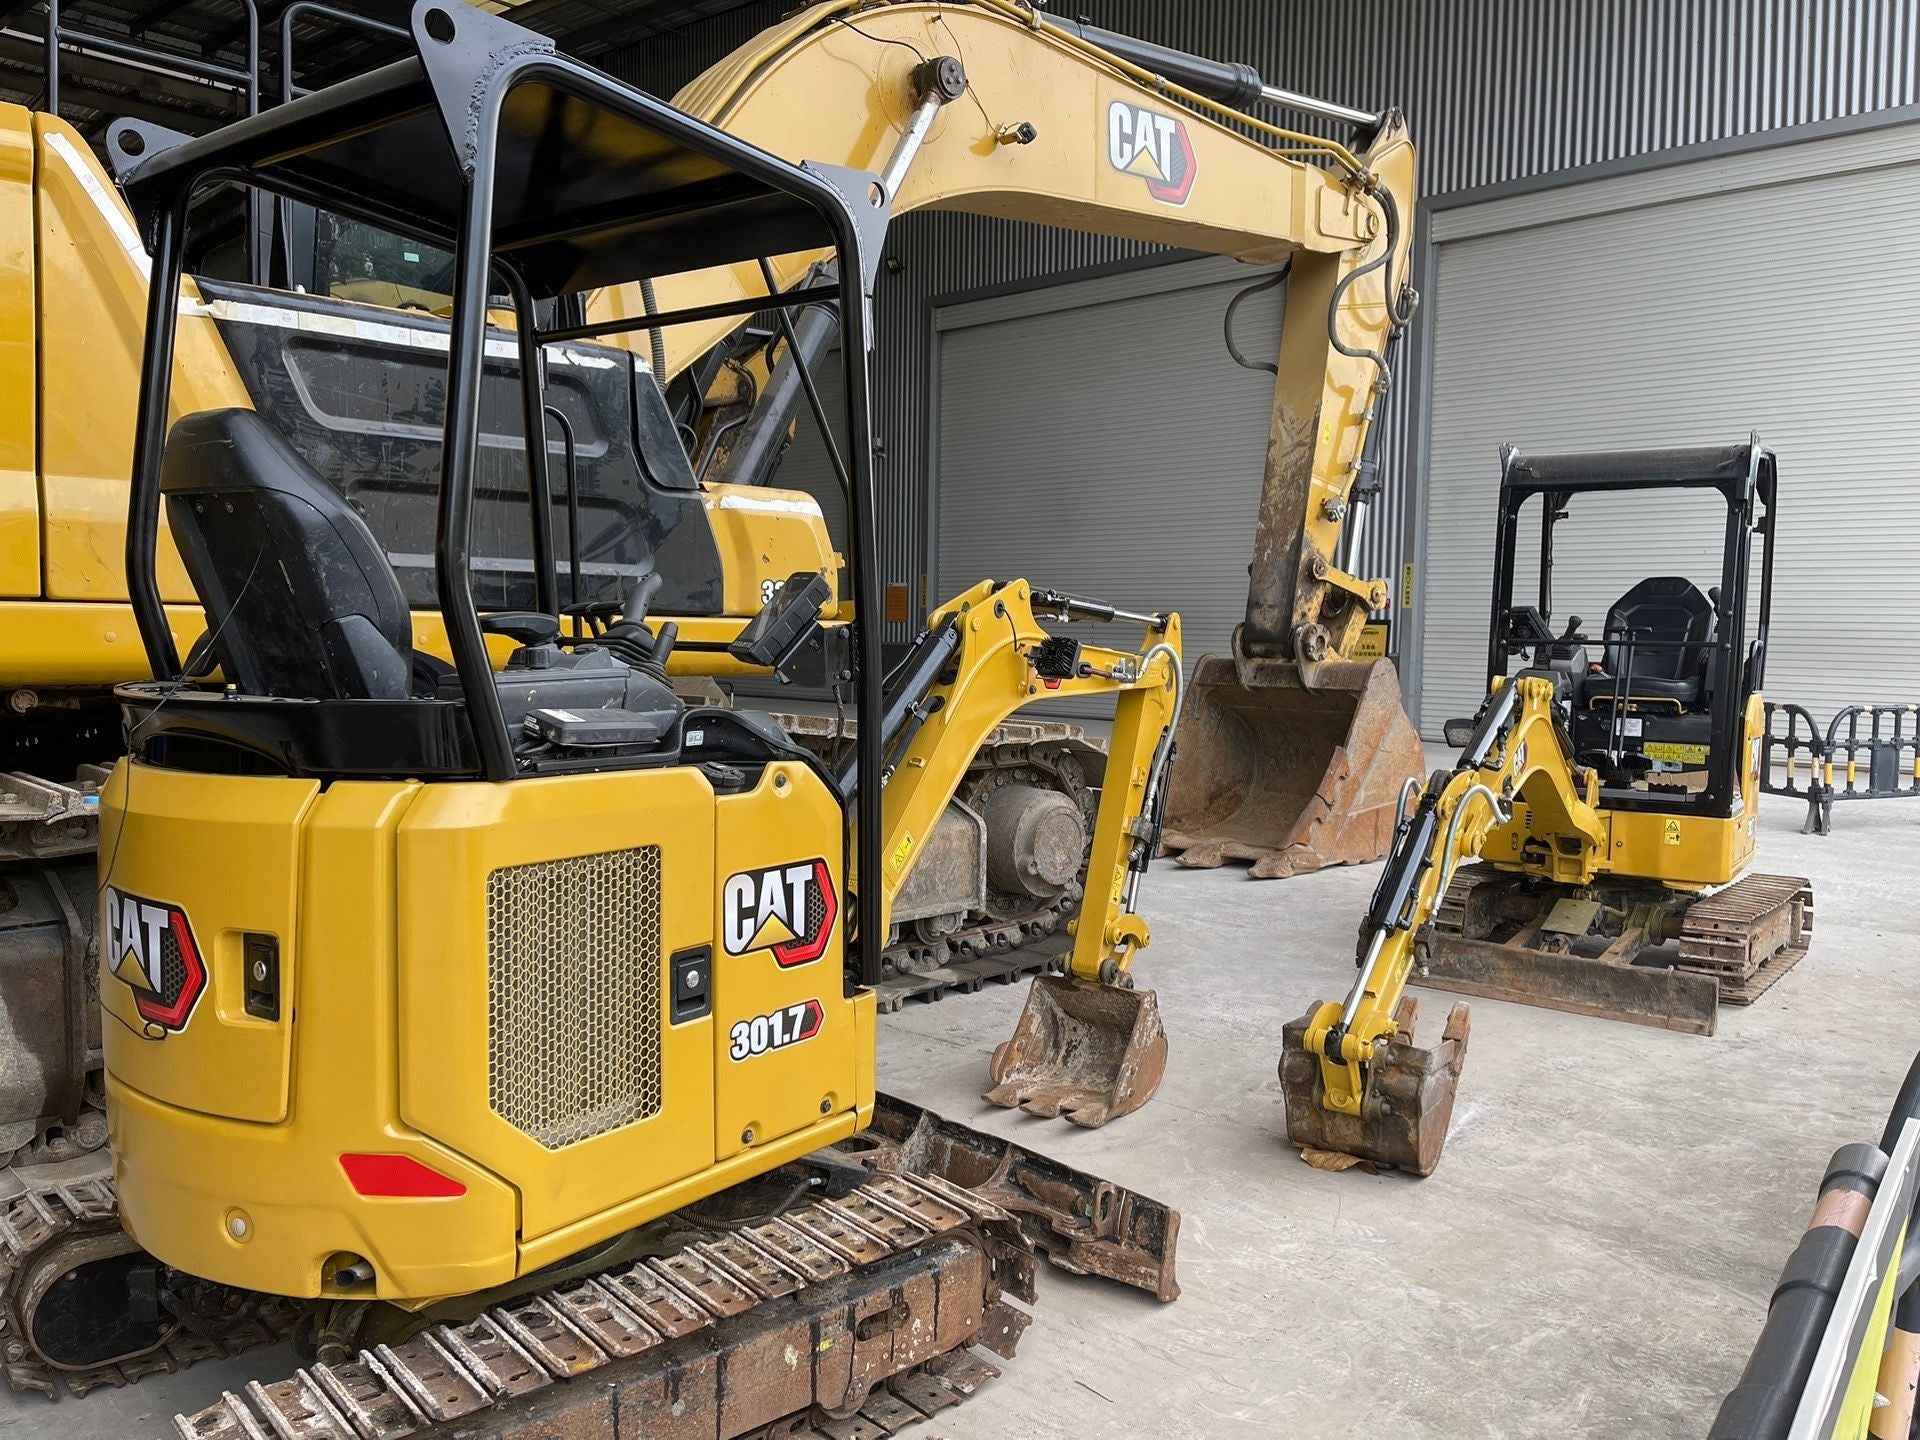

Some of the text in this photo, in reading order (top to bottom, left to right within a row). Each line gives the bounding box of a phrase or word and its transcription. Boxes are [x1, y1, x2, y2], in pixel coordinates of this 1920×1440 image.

[1110, 102, 1175, 181] CAT
[106, 887, 169, 994] CAT
[725, 863, 813, 954] CAT
[731, 1003, 806, 1060] 301.7
